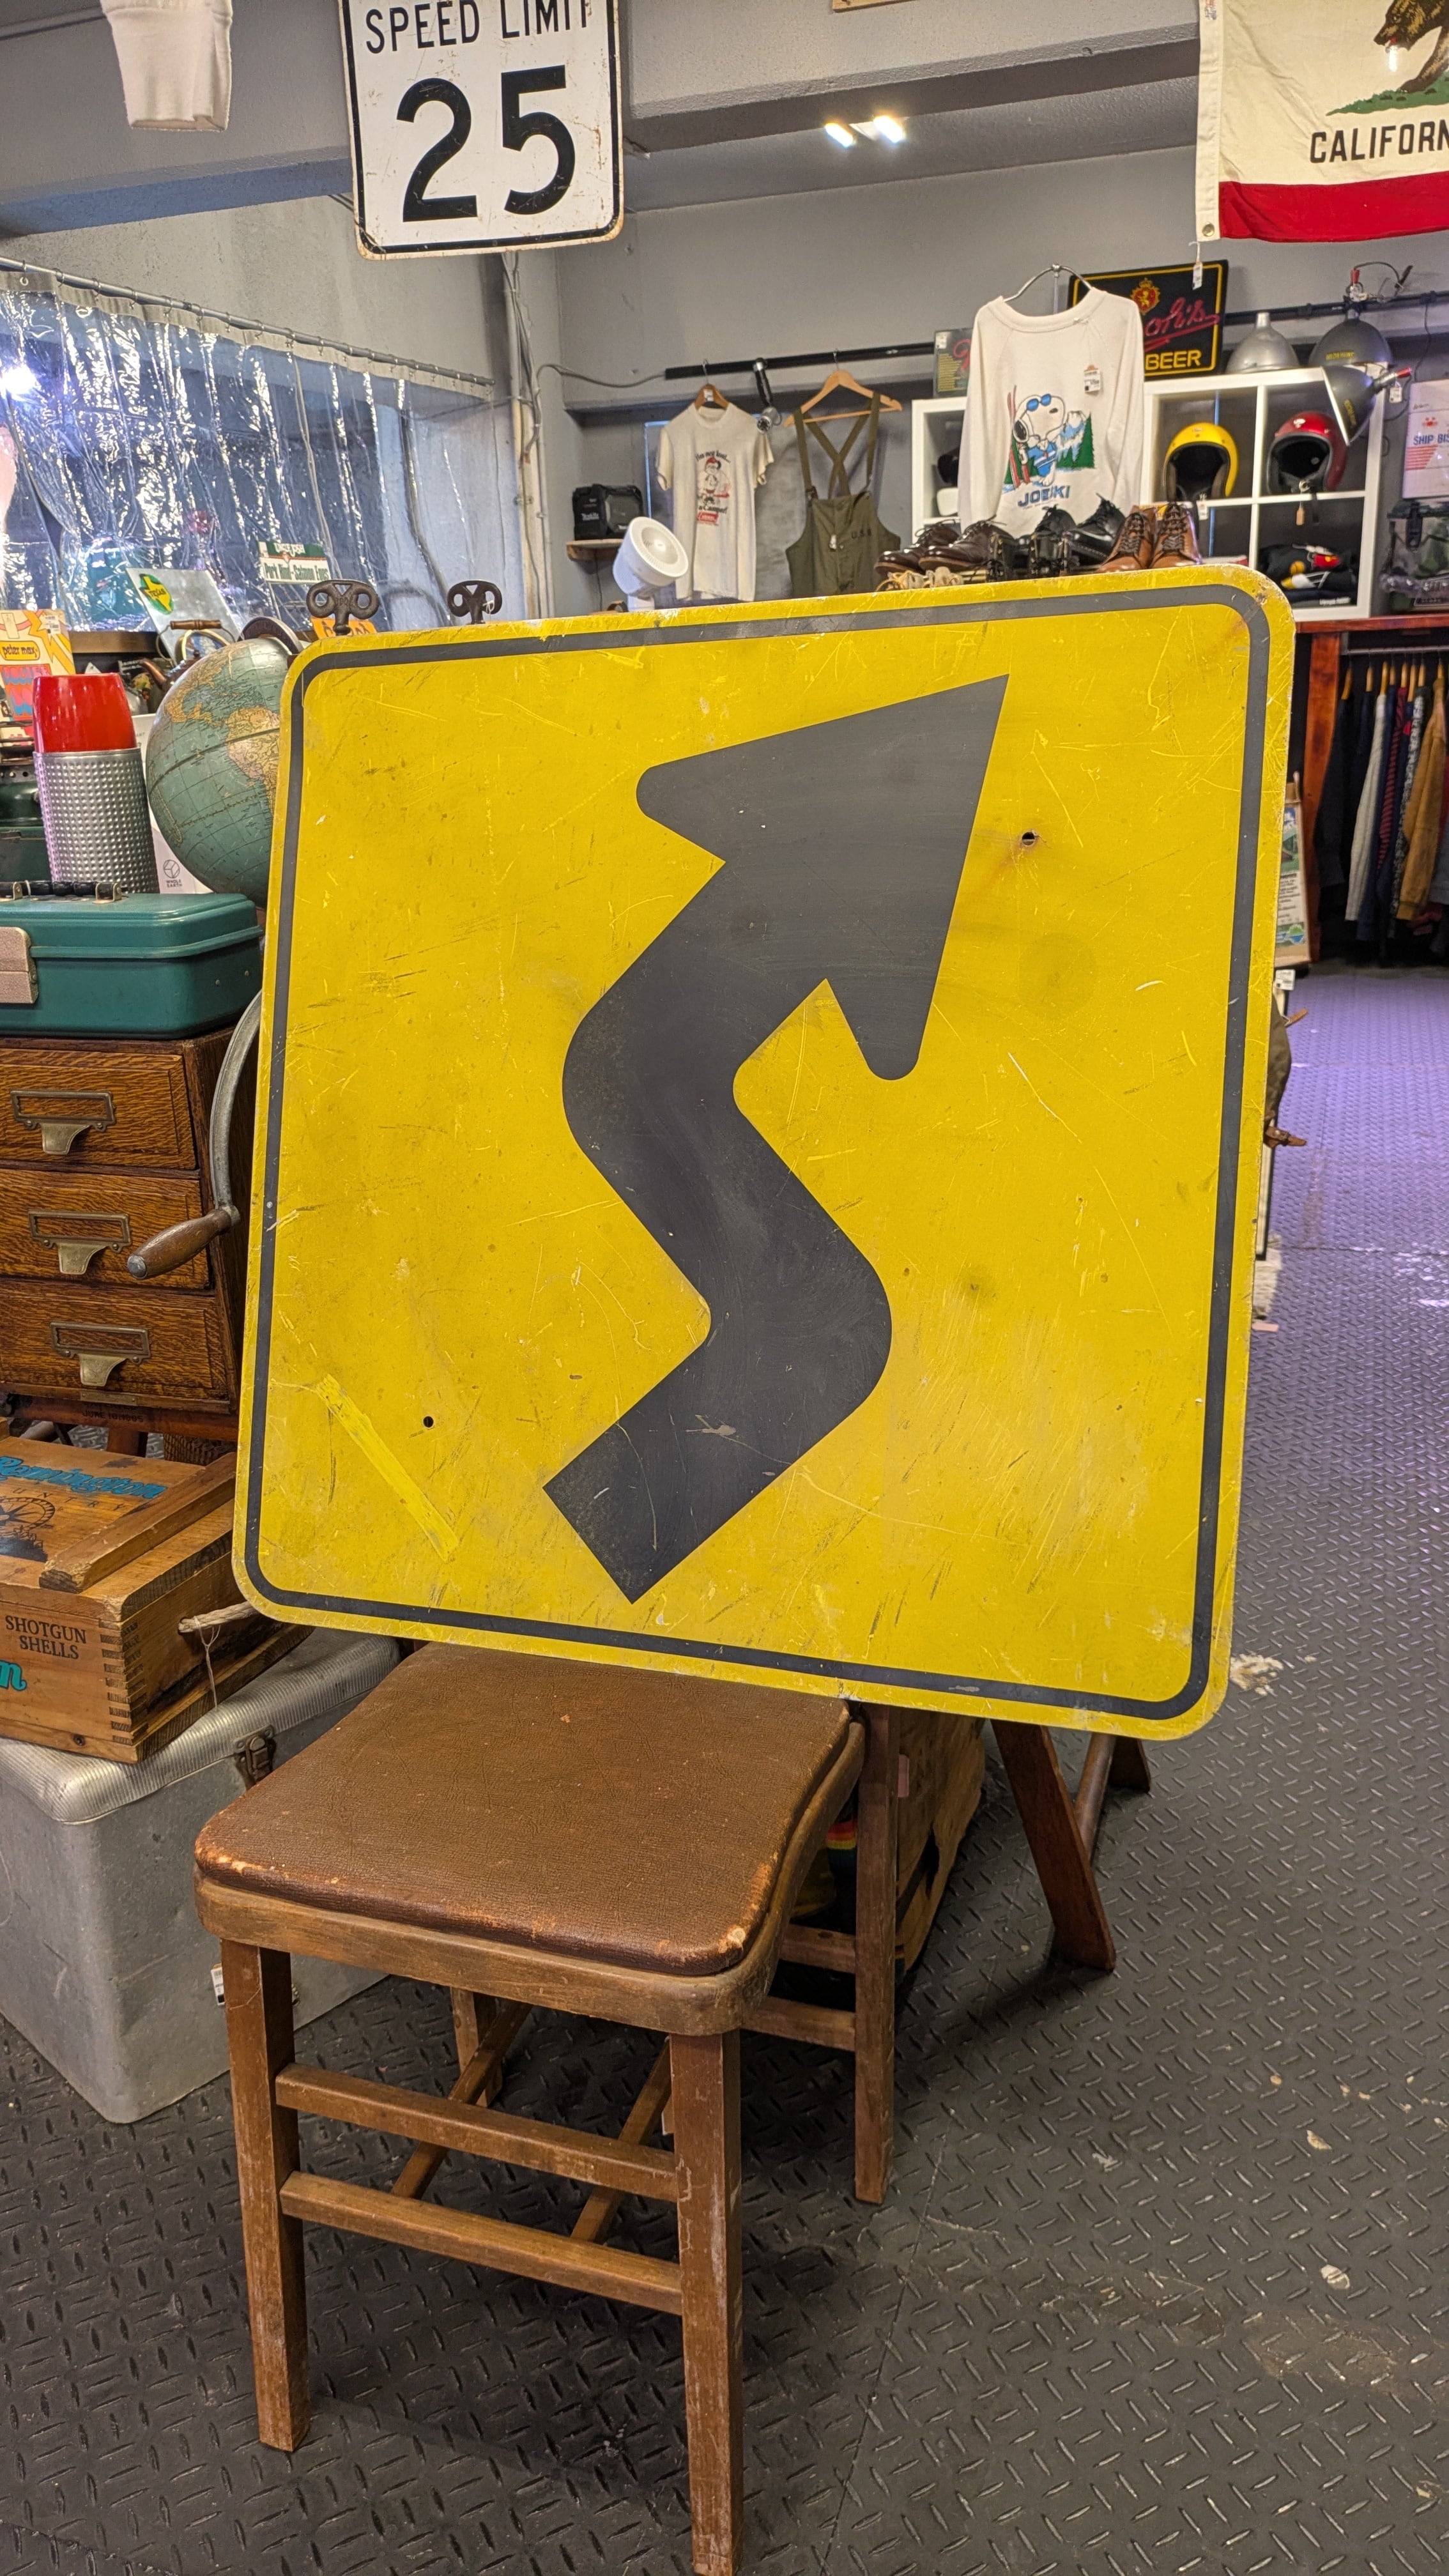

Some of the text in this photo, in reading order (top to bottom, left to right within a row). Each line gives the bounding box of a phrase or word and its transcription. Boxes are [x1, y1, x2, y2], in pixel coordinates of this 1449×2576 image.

[365, 0, 480, 54] SPEED
[396, 65, 576, 222] 25
[1145, 349, 1202, 371] BEER
[1413, 434, 1434, 446] SHIP
[2, 645, 20, 659] peter
[5, 1615, 87, 1644] SHOTGUN
[19, 1635, 79, 1659] SHELLS
